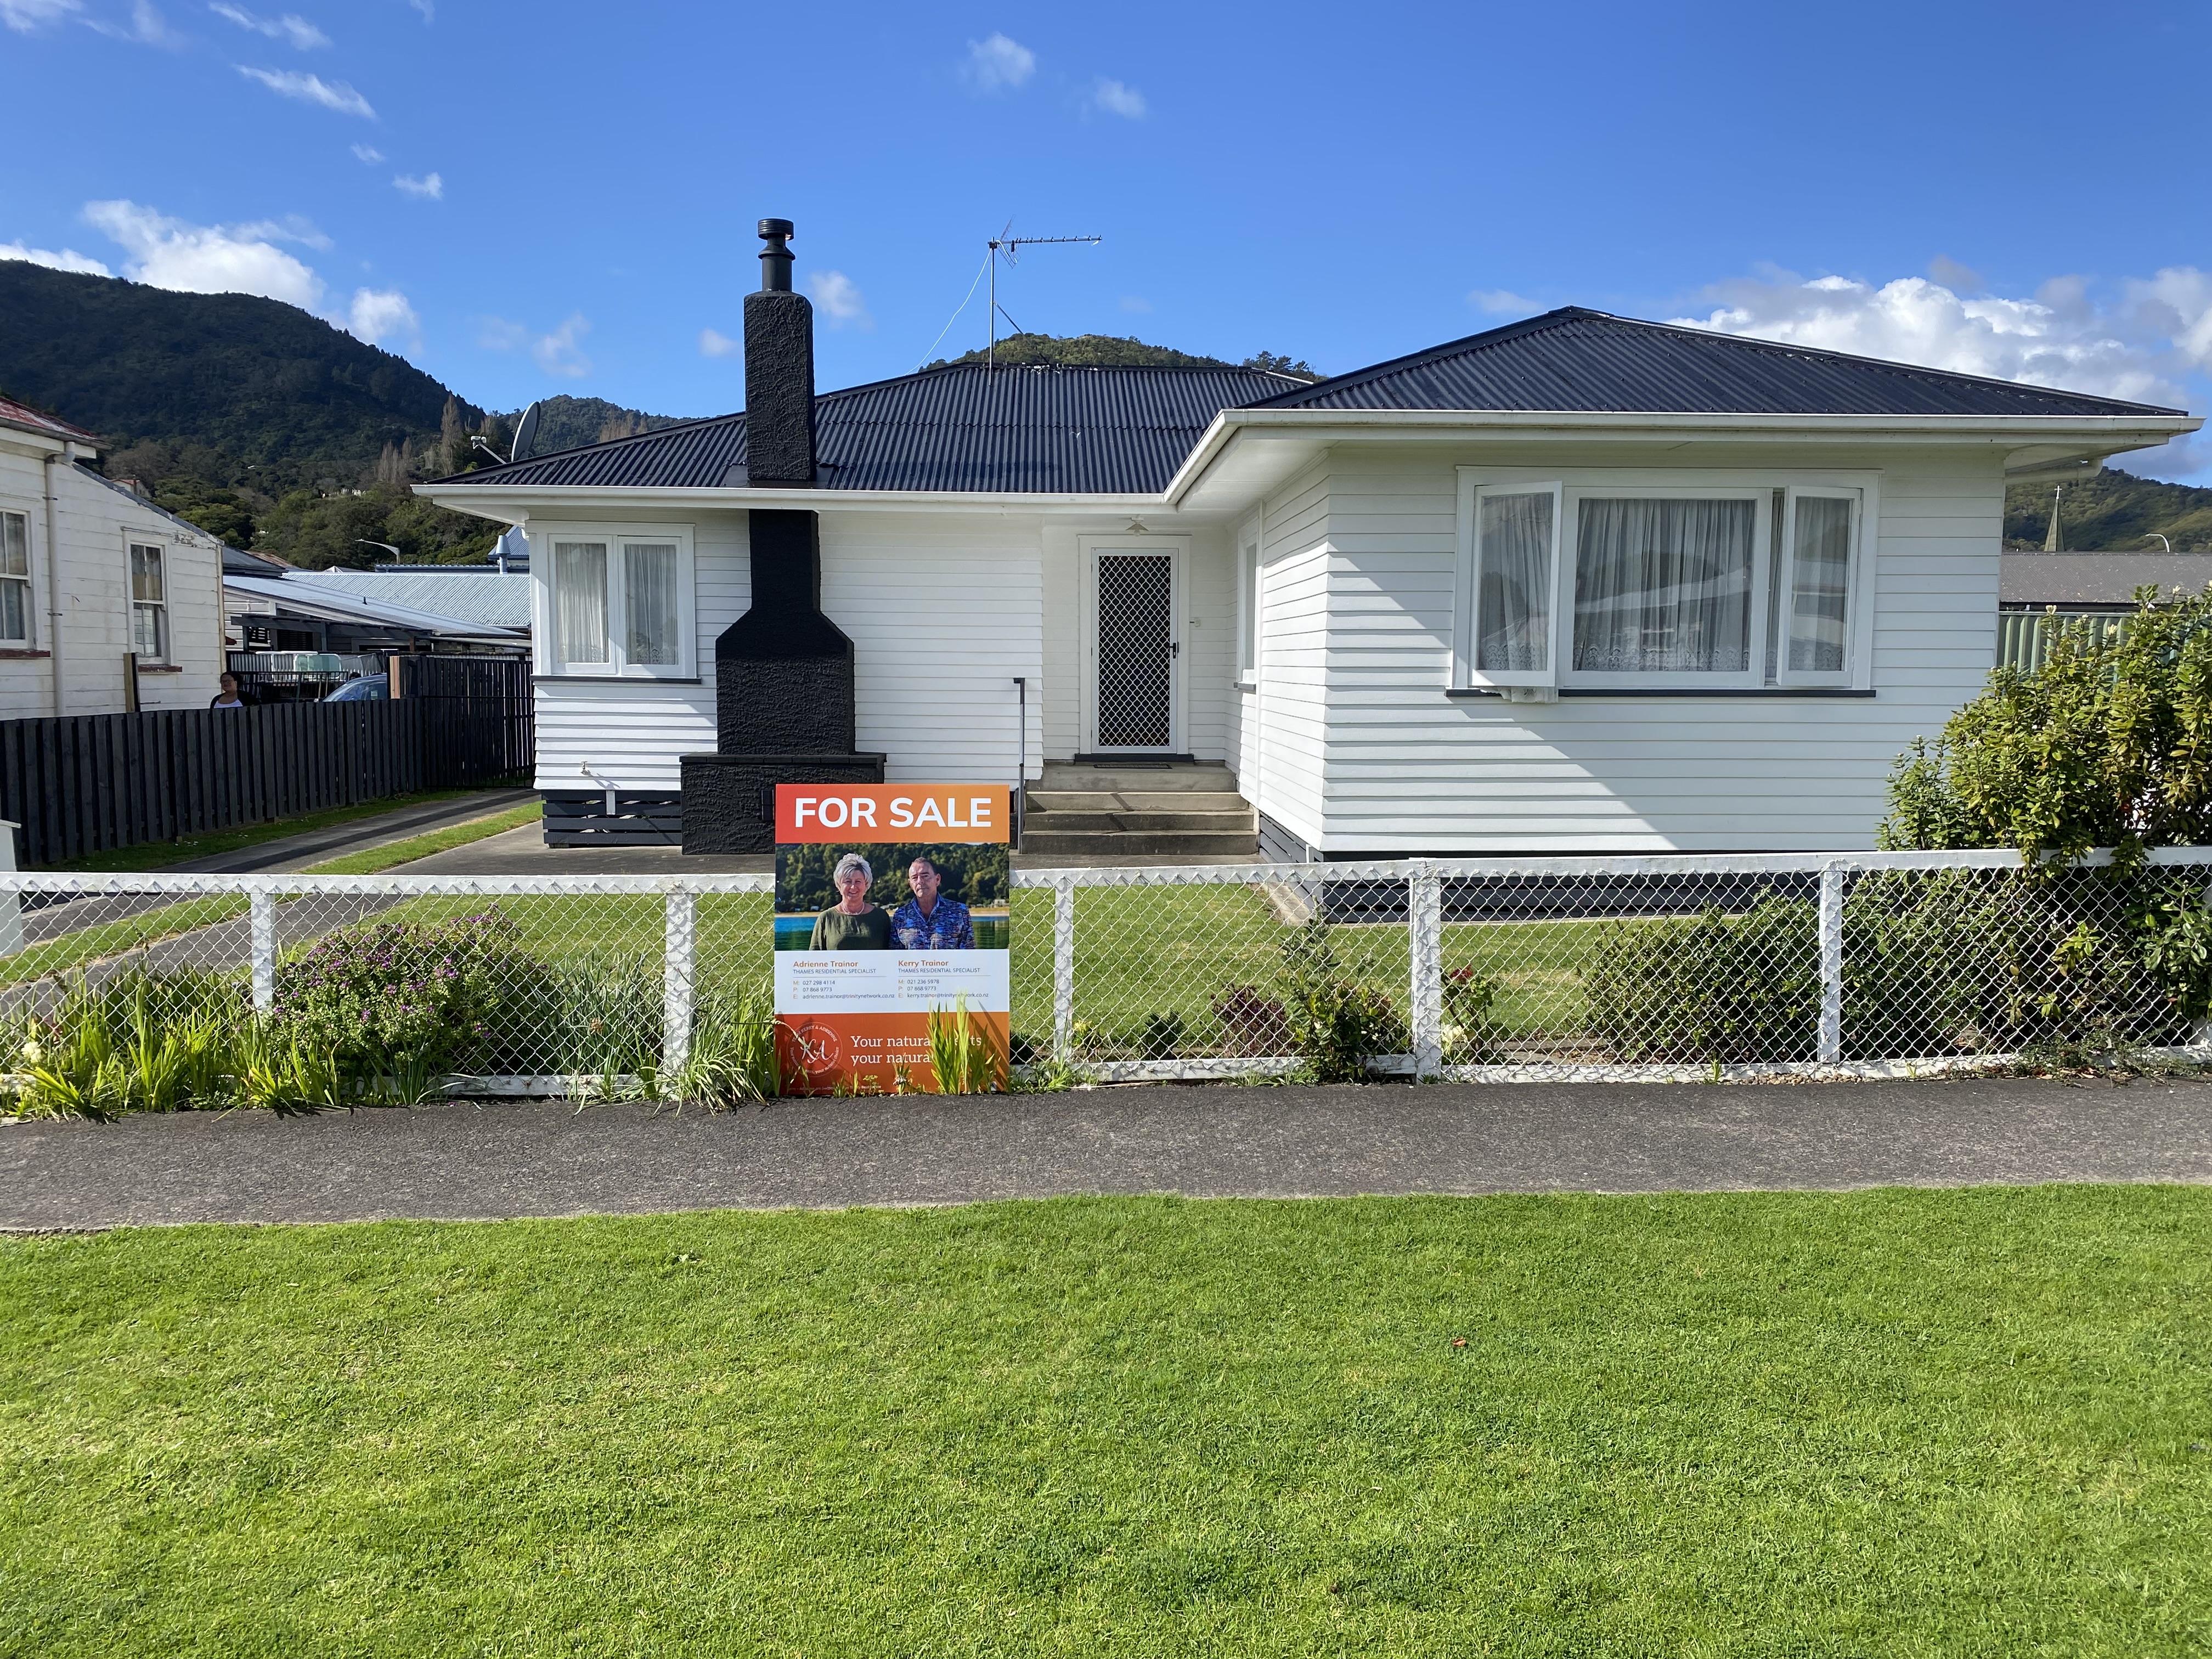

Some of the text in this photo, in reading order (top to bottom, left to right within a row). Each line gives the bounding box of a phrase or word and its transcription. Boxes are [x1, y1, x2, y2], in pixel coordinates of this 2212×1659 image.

[795, 797, 992, 828] FOR SALE
[850, 1035, 883, 1048] Your
[887, 1035, 932, 1047] natura
[850, 1052, 932, 1066] your natura
